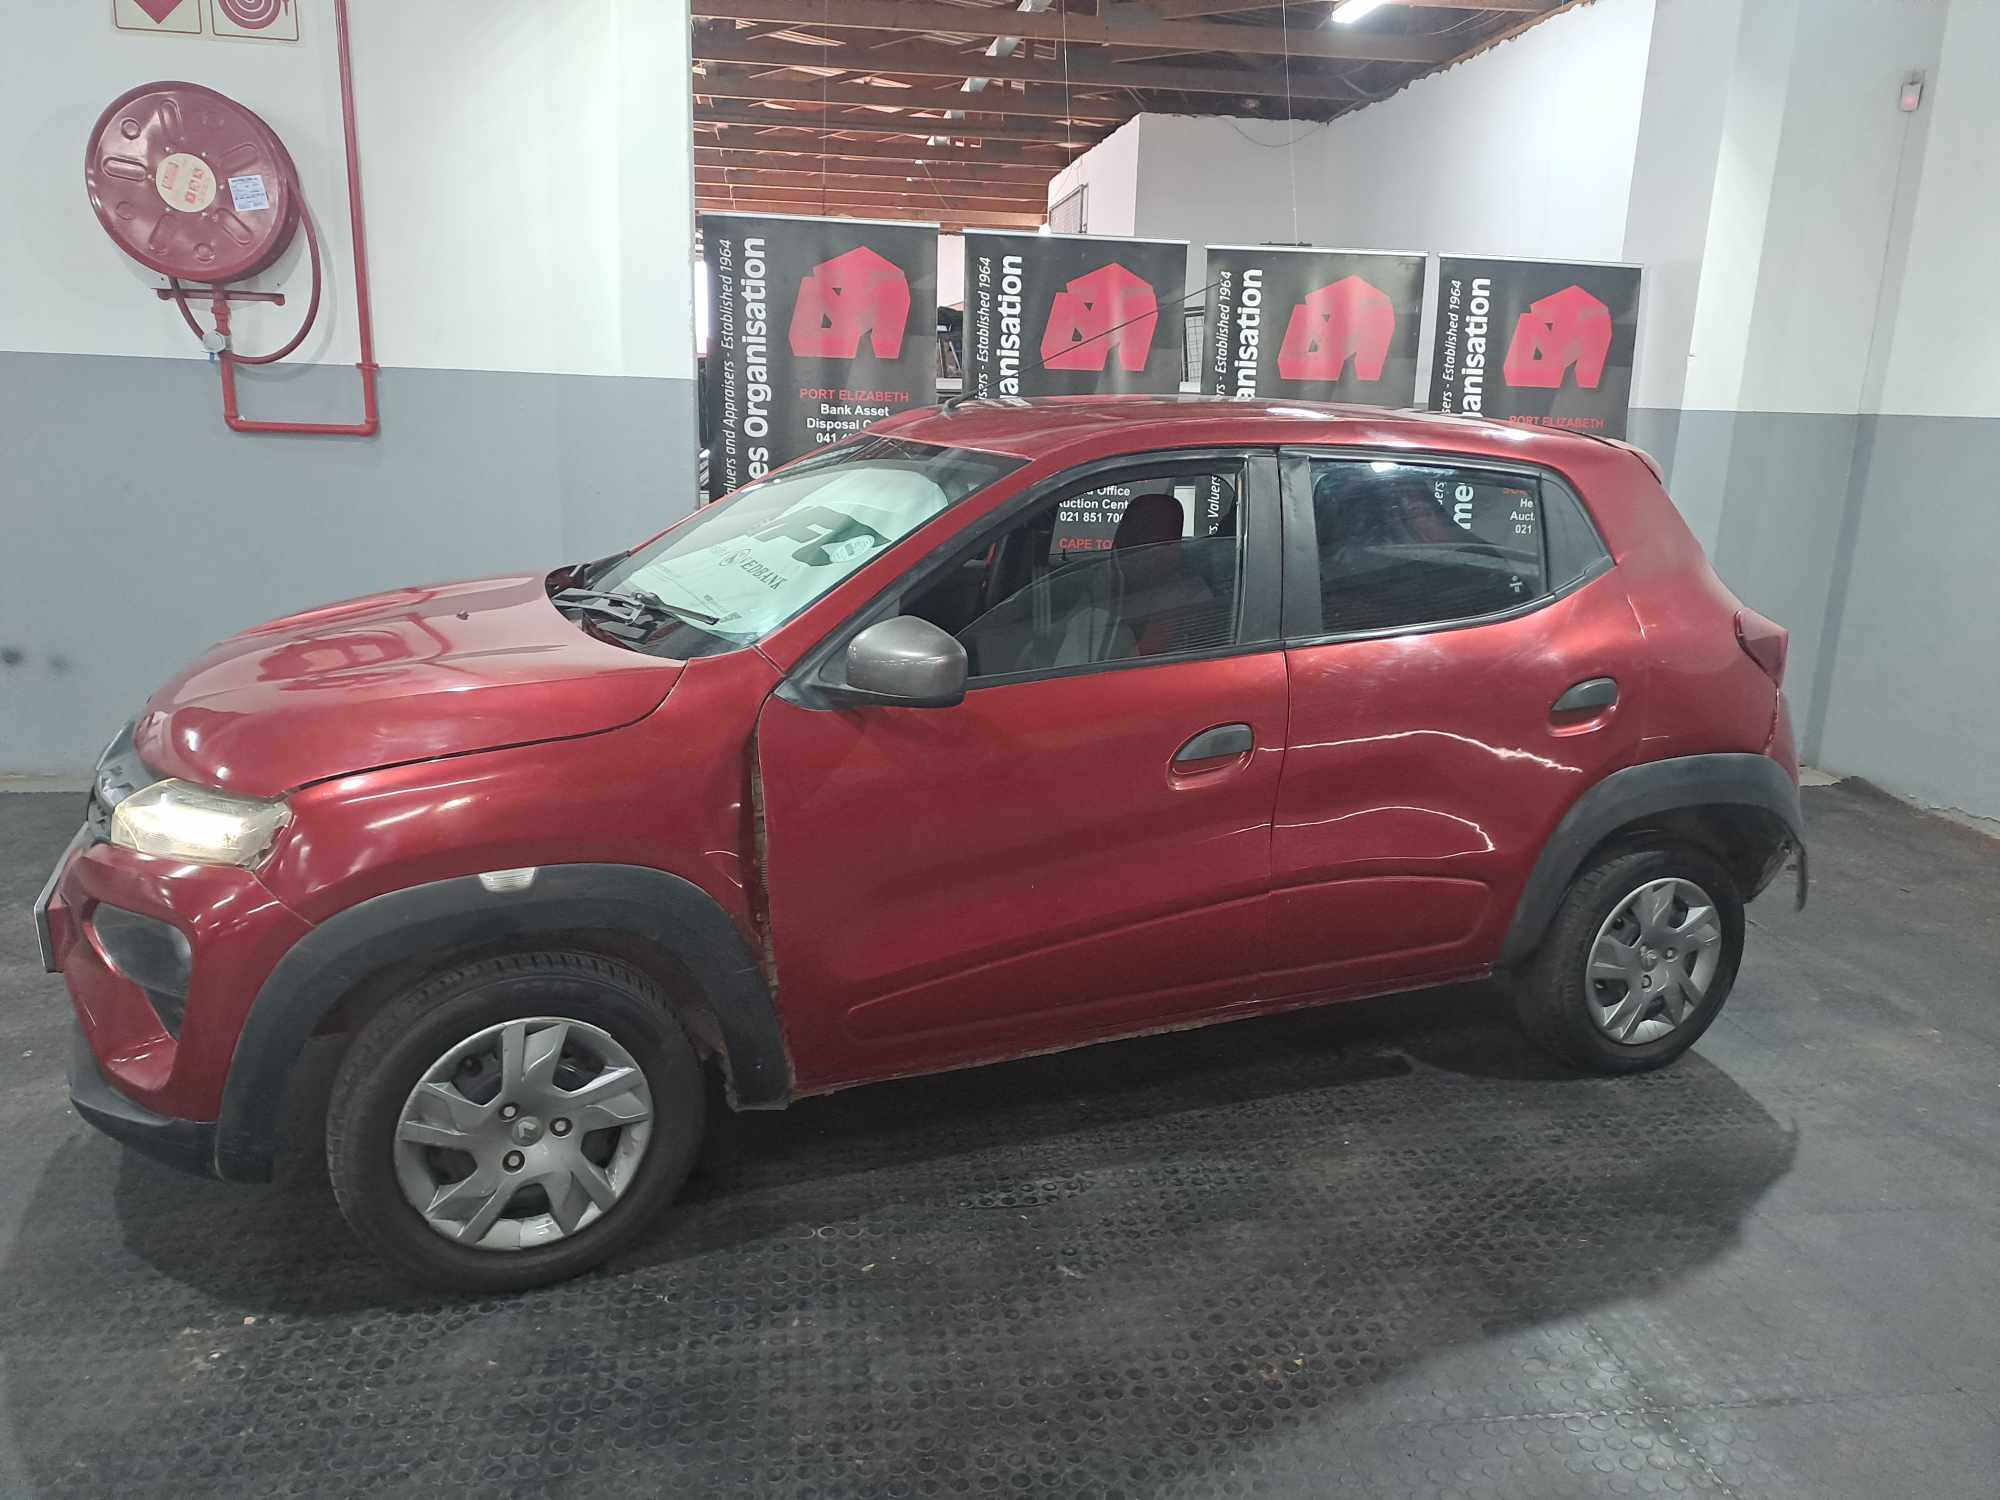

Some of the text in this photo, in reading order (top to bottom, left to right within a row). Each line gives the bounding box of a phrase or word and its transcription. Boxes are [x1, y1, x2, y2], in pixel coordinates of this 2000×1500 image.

[719, 239, 733, 272] 1964
[978, 256, 992, 288] 1964
[1219, 271, 1232, 301] 1964
[1448, 279, 1462, 311] 1964
[719, 274, 734, 349] Established
[976, 291, 990, 362] Established
[996, 255, 1023, 398] anisation
[740, 237, 772, 438] Organisation
[1214, 304, 1231, 374] Established
[1441, 312, 1460, 382] Established
[1461, 278, 1491, 417] anisation
[721, 361, 738, 427] Appraisers
[800, 388, 910, 403] PORT ELIZABETH
[820, 403, 890, 417] Bank Asset
[806, 417, 859, 431] Disposal
[815, 432, 837, 444] 041
[722, 430, 736, 456] and
[722, 457, 736, 496] aluers
[1207, 475, 1222, 518] Valuers
[1453, 482, 1474, 530] me
[1059, 511, 1079, 521] 021
[1083, 512, 1102, 523] 851
[1509, 510, 1536, 521] Auct
[1515, 523, 1532, 535] 021
[1058, 537, 1092, 549] CAPE
